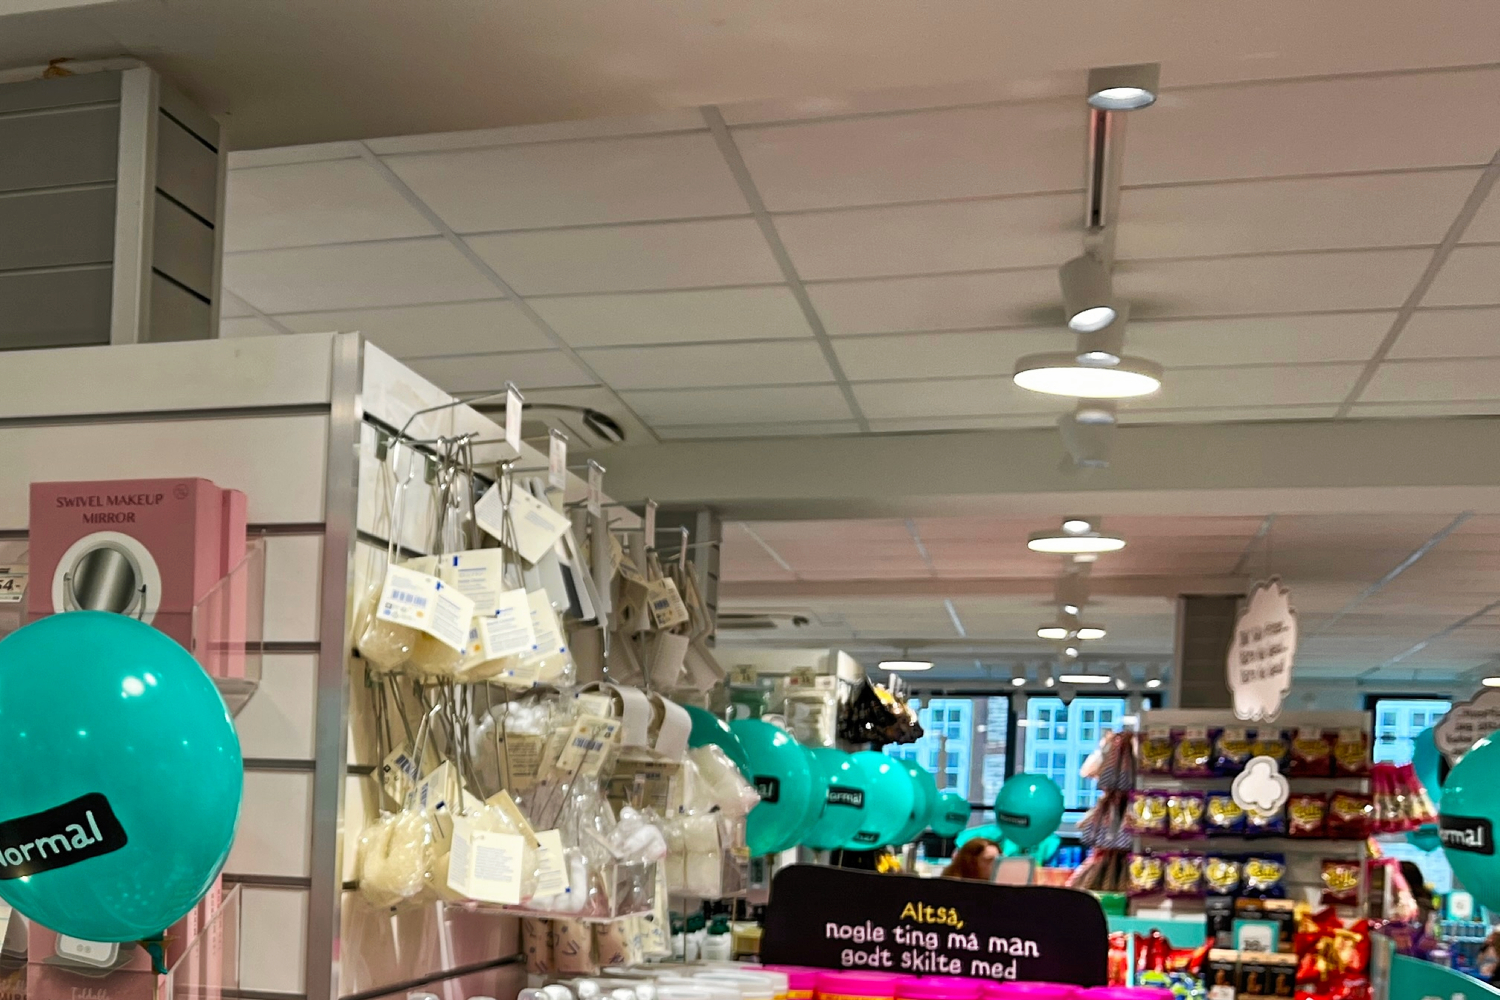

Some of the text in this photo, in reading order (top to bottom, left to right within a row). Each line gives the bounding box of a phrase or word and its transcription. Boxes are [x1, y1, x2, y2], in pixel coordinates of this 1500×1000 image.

[56, 493, 164, 508] SWIVEL MAKEUP
[82, 512, 136, 524] MIRROR
[828, 791, 862, 804] ormal
[1439, 825, 1485, 848] ormal
[826, 920, 885, 944] nogle
[892, 925, 939, 950] ting
[988, 936, 1040, 958] man
[841, 945, 1017, 980] godt skilte med
